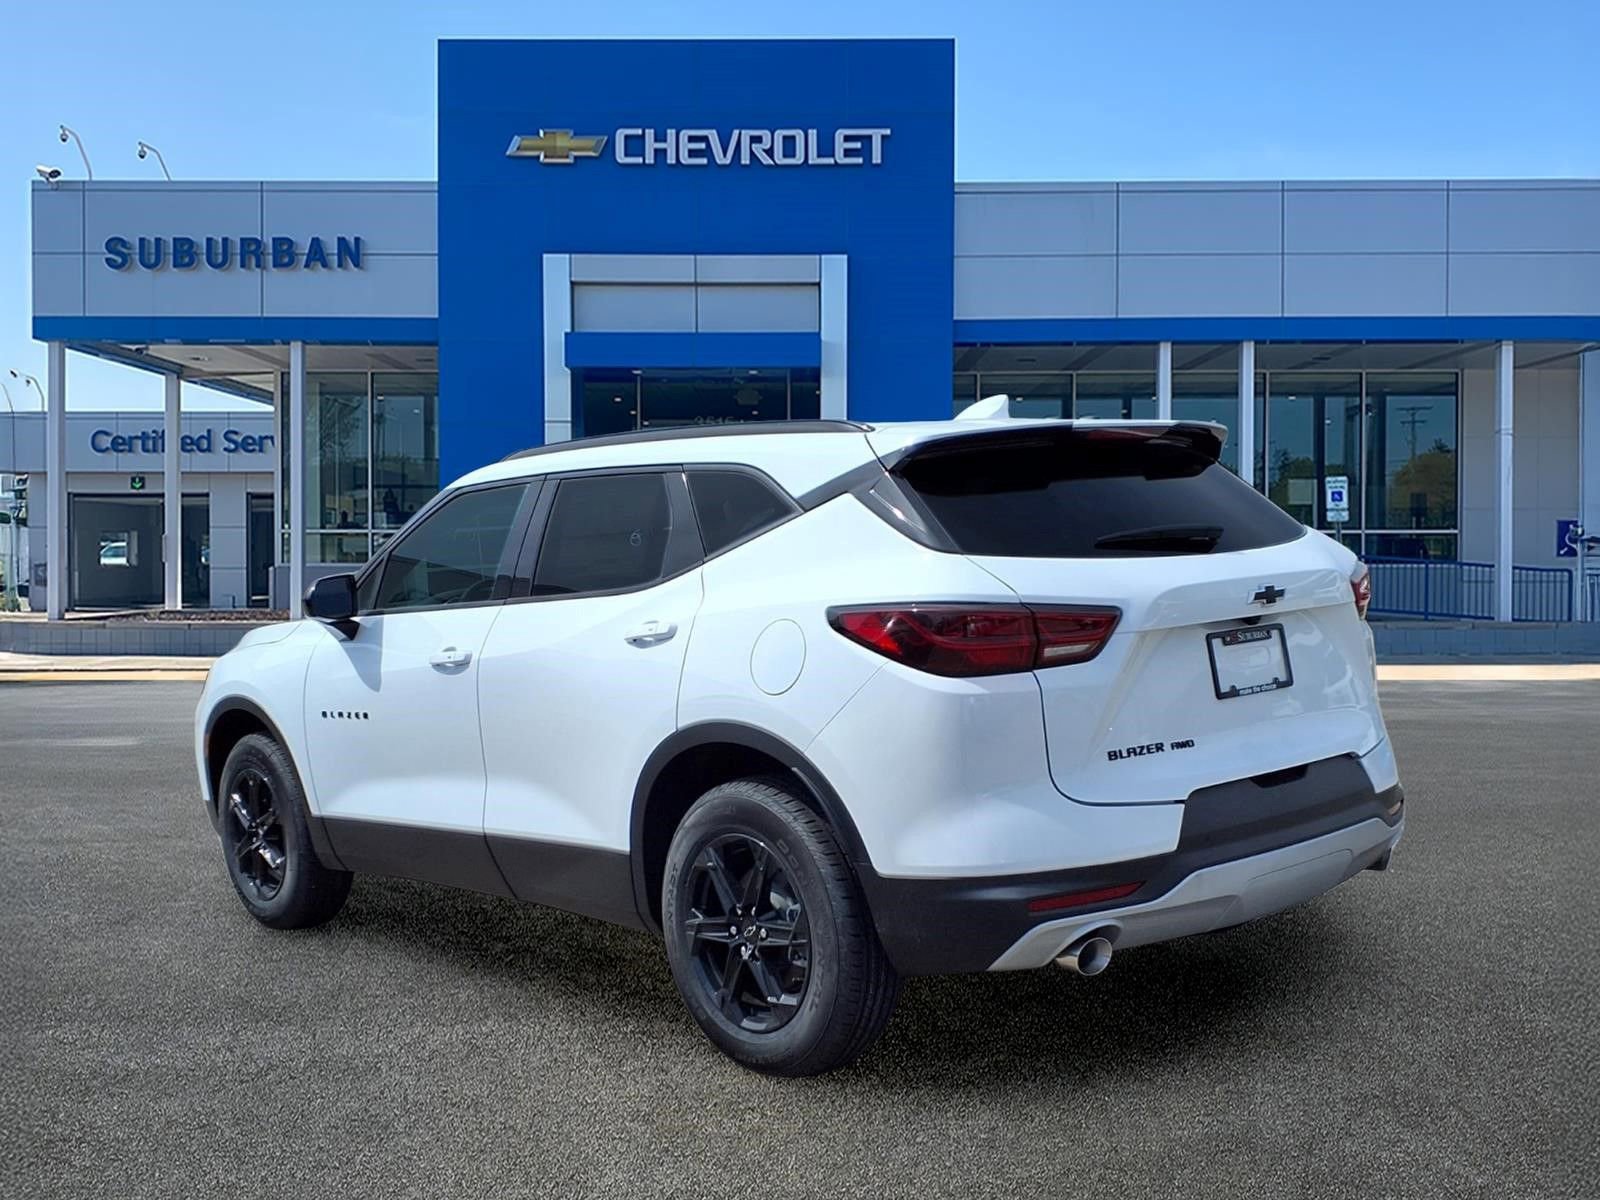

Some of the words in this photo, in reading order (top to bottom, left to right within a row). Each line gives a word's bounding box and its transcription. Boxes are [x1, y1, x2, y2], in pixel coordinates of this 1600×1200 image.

[614, 128, 892, 166] CHEVROLET
[104, 235, 364, 271] SUBURBAN
[90, 429, 212, 454] Certifed
[321, 711, 369, 720] BLAZER
[1107, 742, 1165, 761] BLAZER
[1170, 739, 1195, 751] AWD
